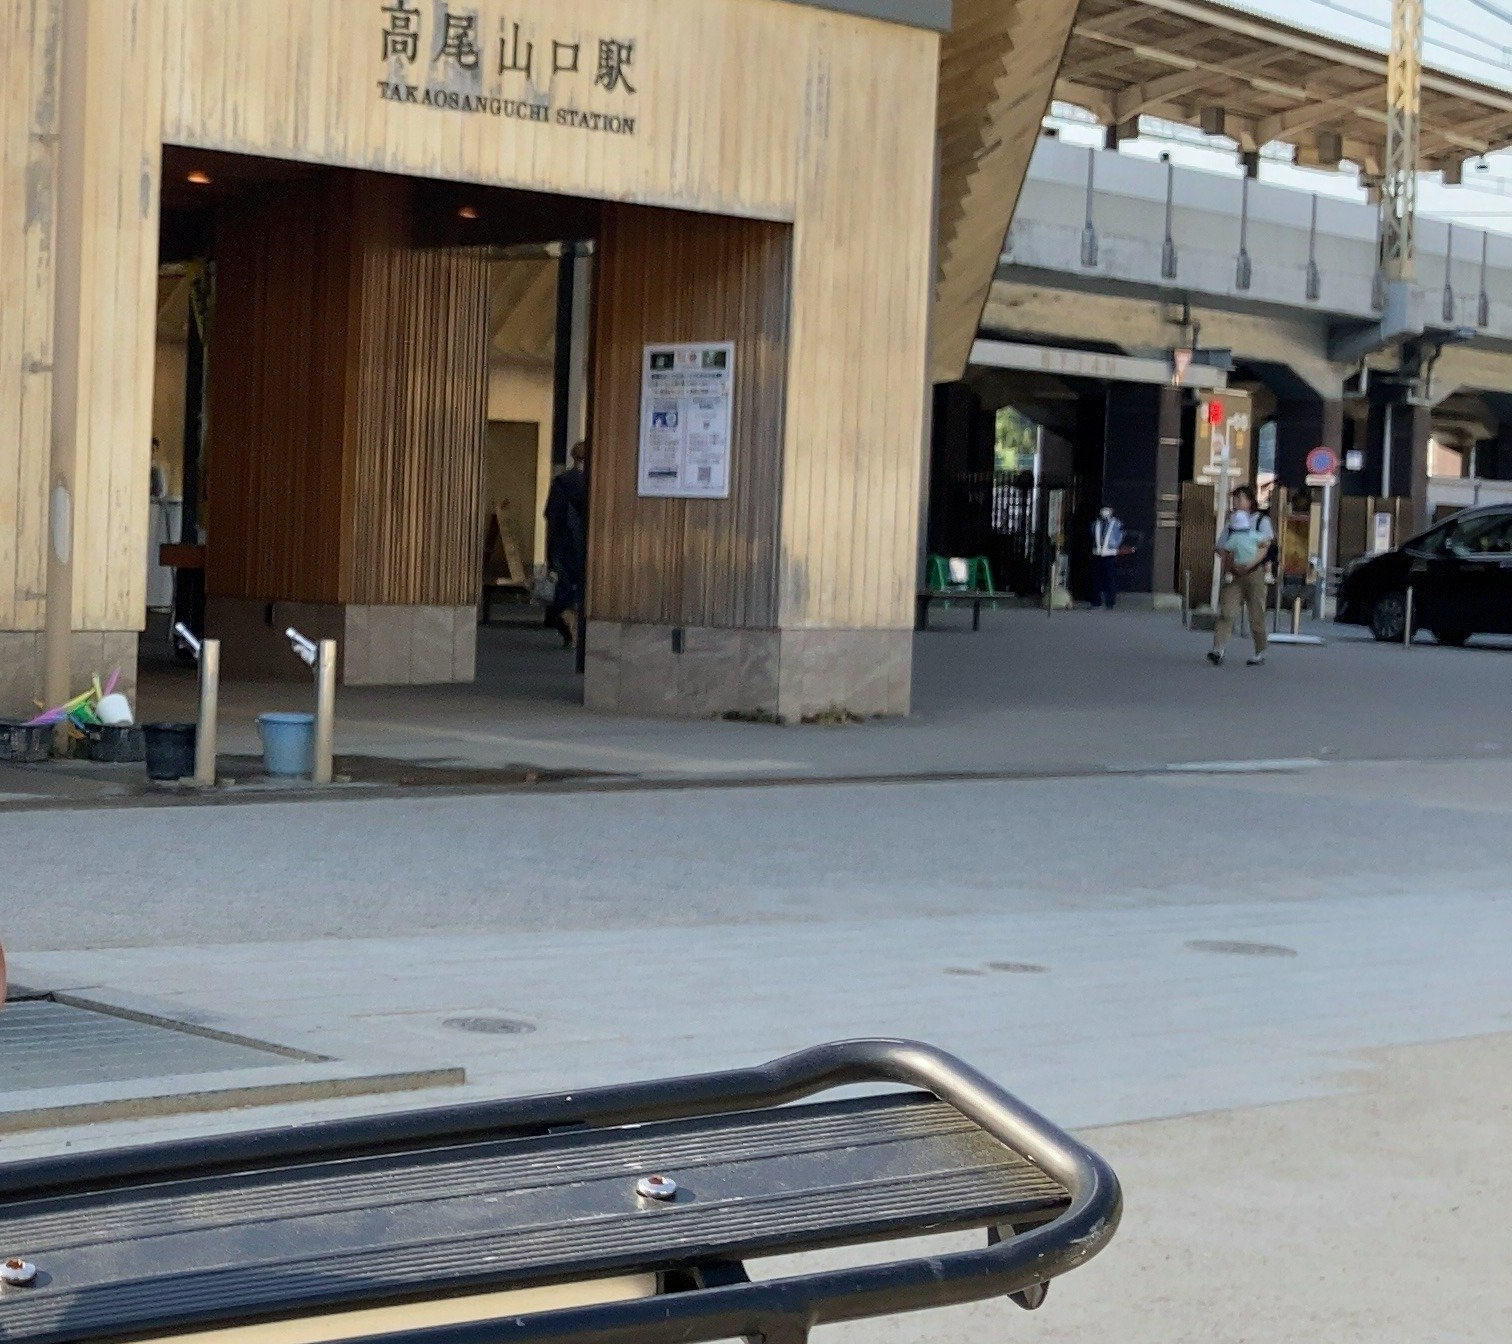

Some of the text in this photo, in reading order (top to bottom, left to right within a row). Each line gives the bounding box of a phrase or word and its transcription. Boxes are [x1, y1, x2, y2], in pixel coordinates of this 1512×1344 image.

[380, 0, 637, 95] 高尾山口駅
[377, 81, 636, 136] TAKAOSANGUCHI STATION
